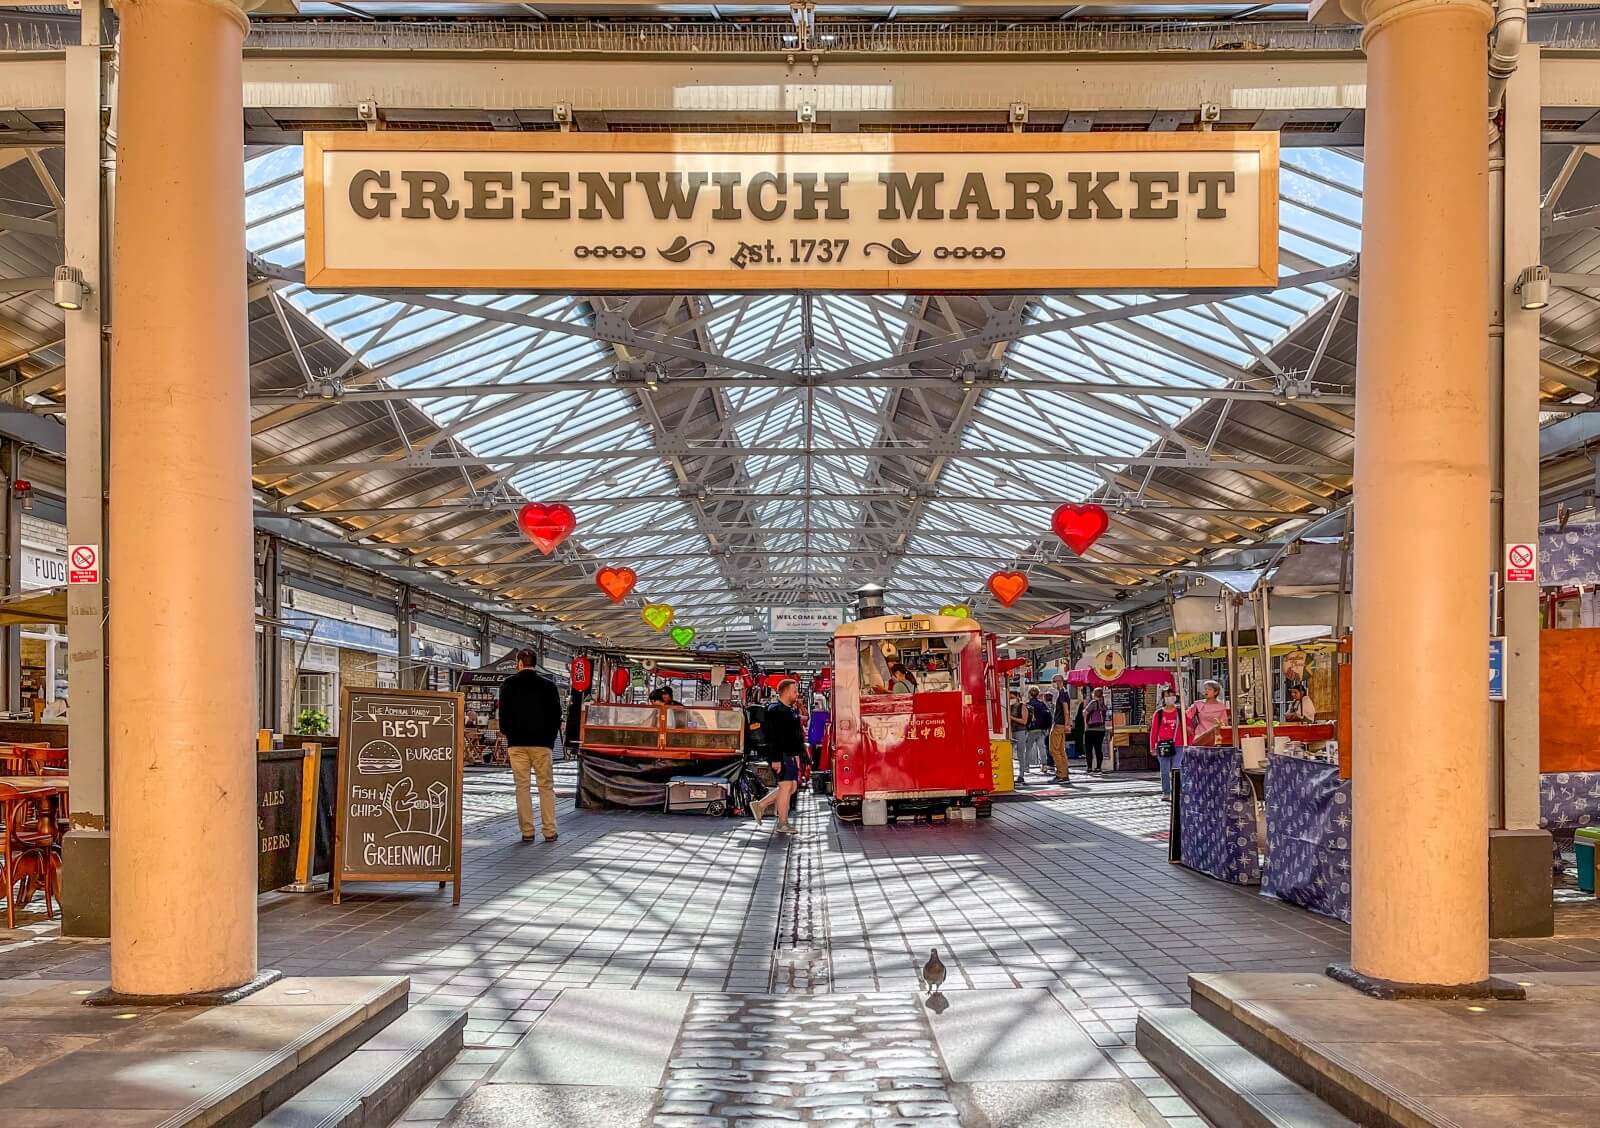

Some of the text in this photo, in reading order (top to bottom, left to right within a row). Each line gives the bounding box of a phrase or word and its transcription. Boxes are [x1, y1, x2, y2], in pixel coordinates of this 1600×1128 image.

[348, 169, 1236, 221] GREENWICH MARKET
[730, 239, 850, 270] Est. 1737
[472, 674, 496, 682] Ideal
[371, 705, 383, 713] THE
[385, 706, 409, 715] ADMIRAL
[382, 720, 430, 738] BEST
[405, 747, 453, 760] BURGER
[262, 790, 285, 807] ALES
[352, 785, 377, 800] FISH
[350, 803, 383, 817] CHIPS
[262, 833, 290, 853] BEERS
[363, 832, 375, 843] IN
[363, 843, 442, 866] GREENWICH
